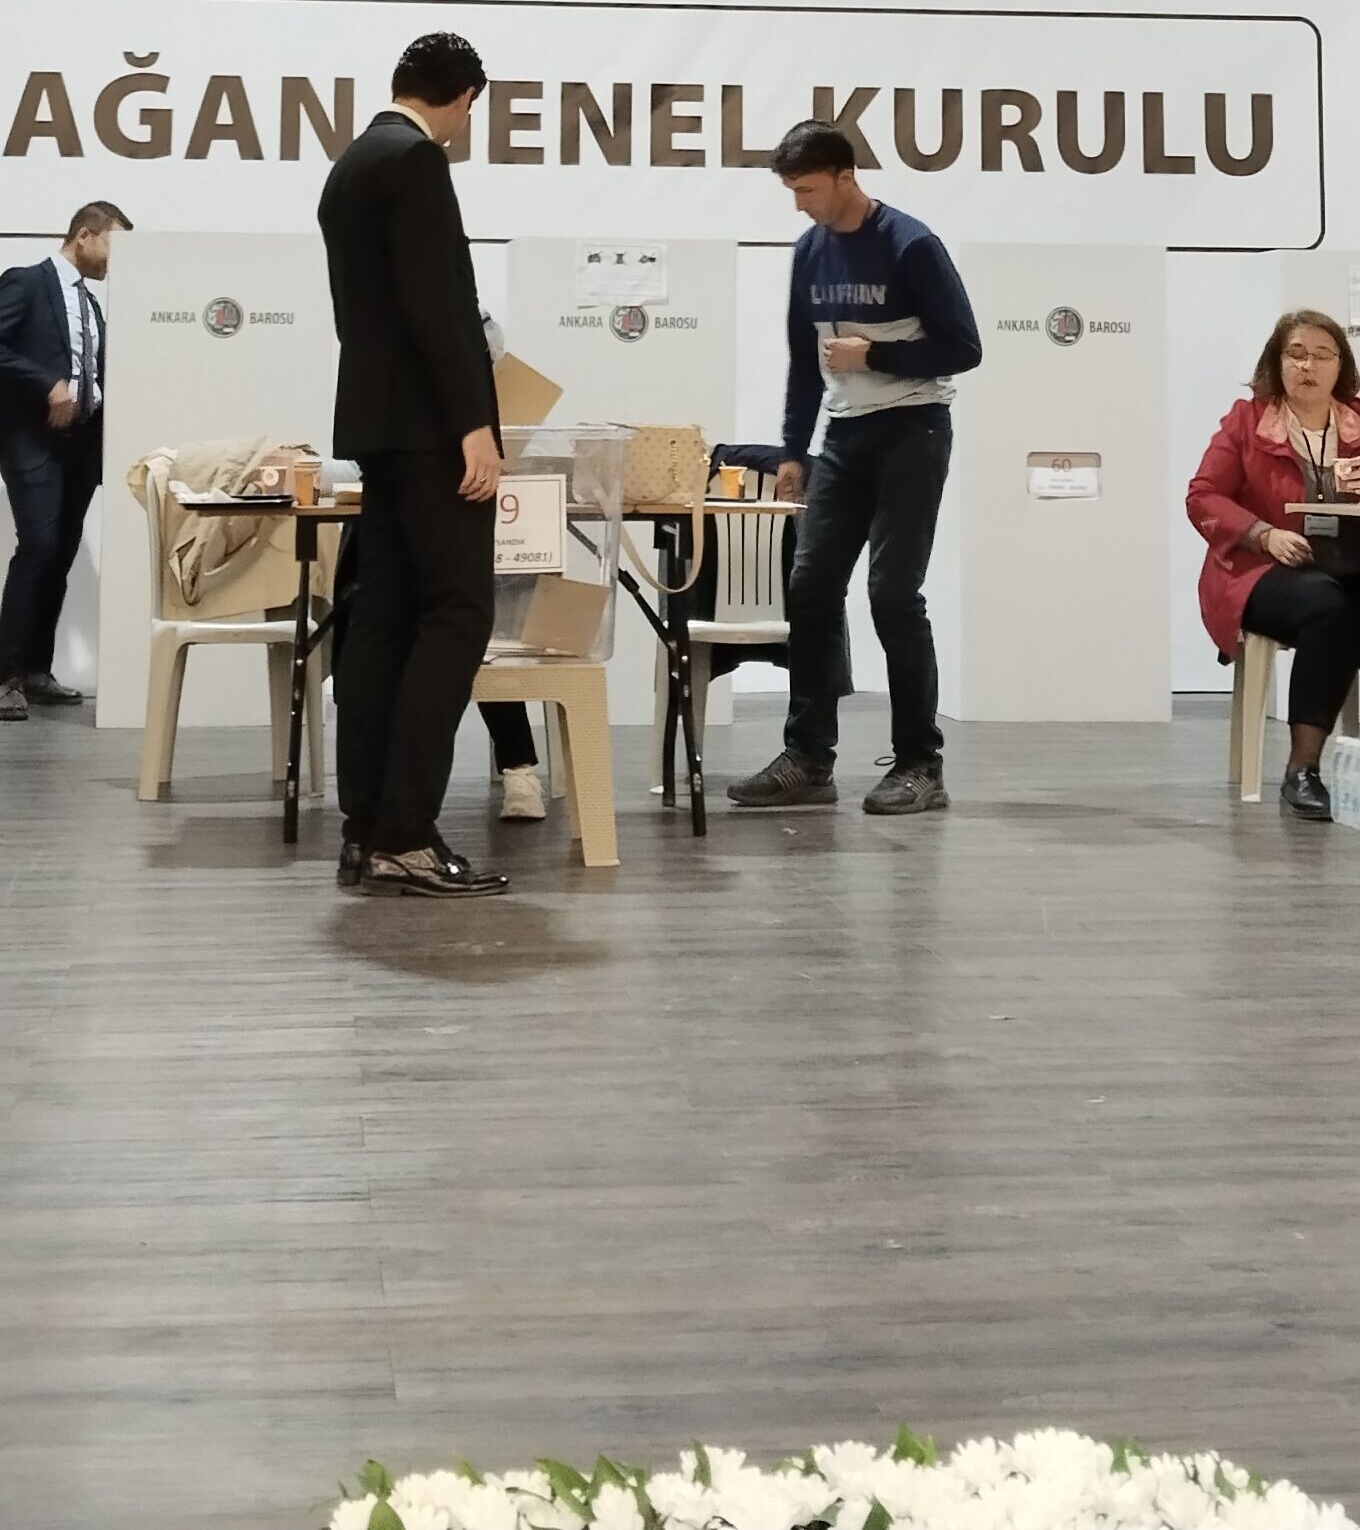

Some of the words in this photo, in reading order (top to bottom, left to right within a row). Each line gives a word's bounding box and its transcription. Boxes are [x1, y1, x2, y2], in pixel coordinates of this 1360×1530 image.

[447, 80, 774, 168] ENEL
[813, 86, 1273, 176] KURULU
[150, 311, 196, 323] ANKARA
[250, 312, 295, 324] BAROSU
[559, 316, 603, 328] ANKARA
[654, 317, 698, 329] BAROSU
[997, 320, 1040, 331] ANKARA
[1089, 321, 1131, 333] BAROSU
[1052, 458, 1072, 472] 60
[500, 494, 519, 524] 9
